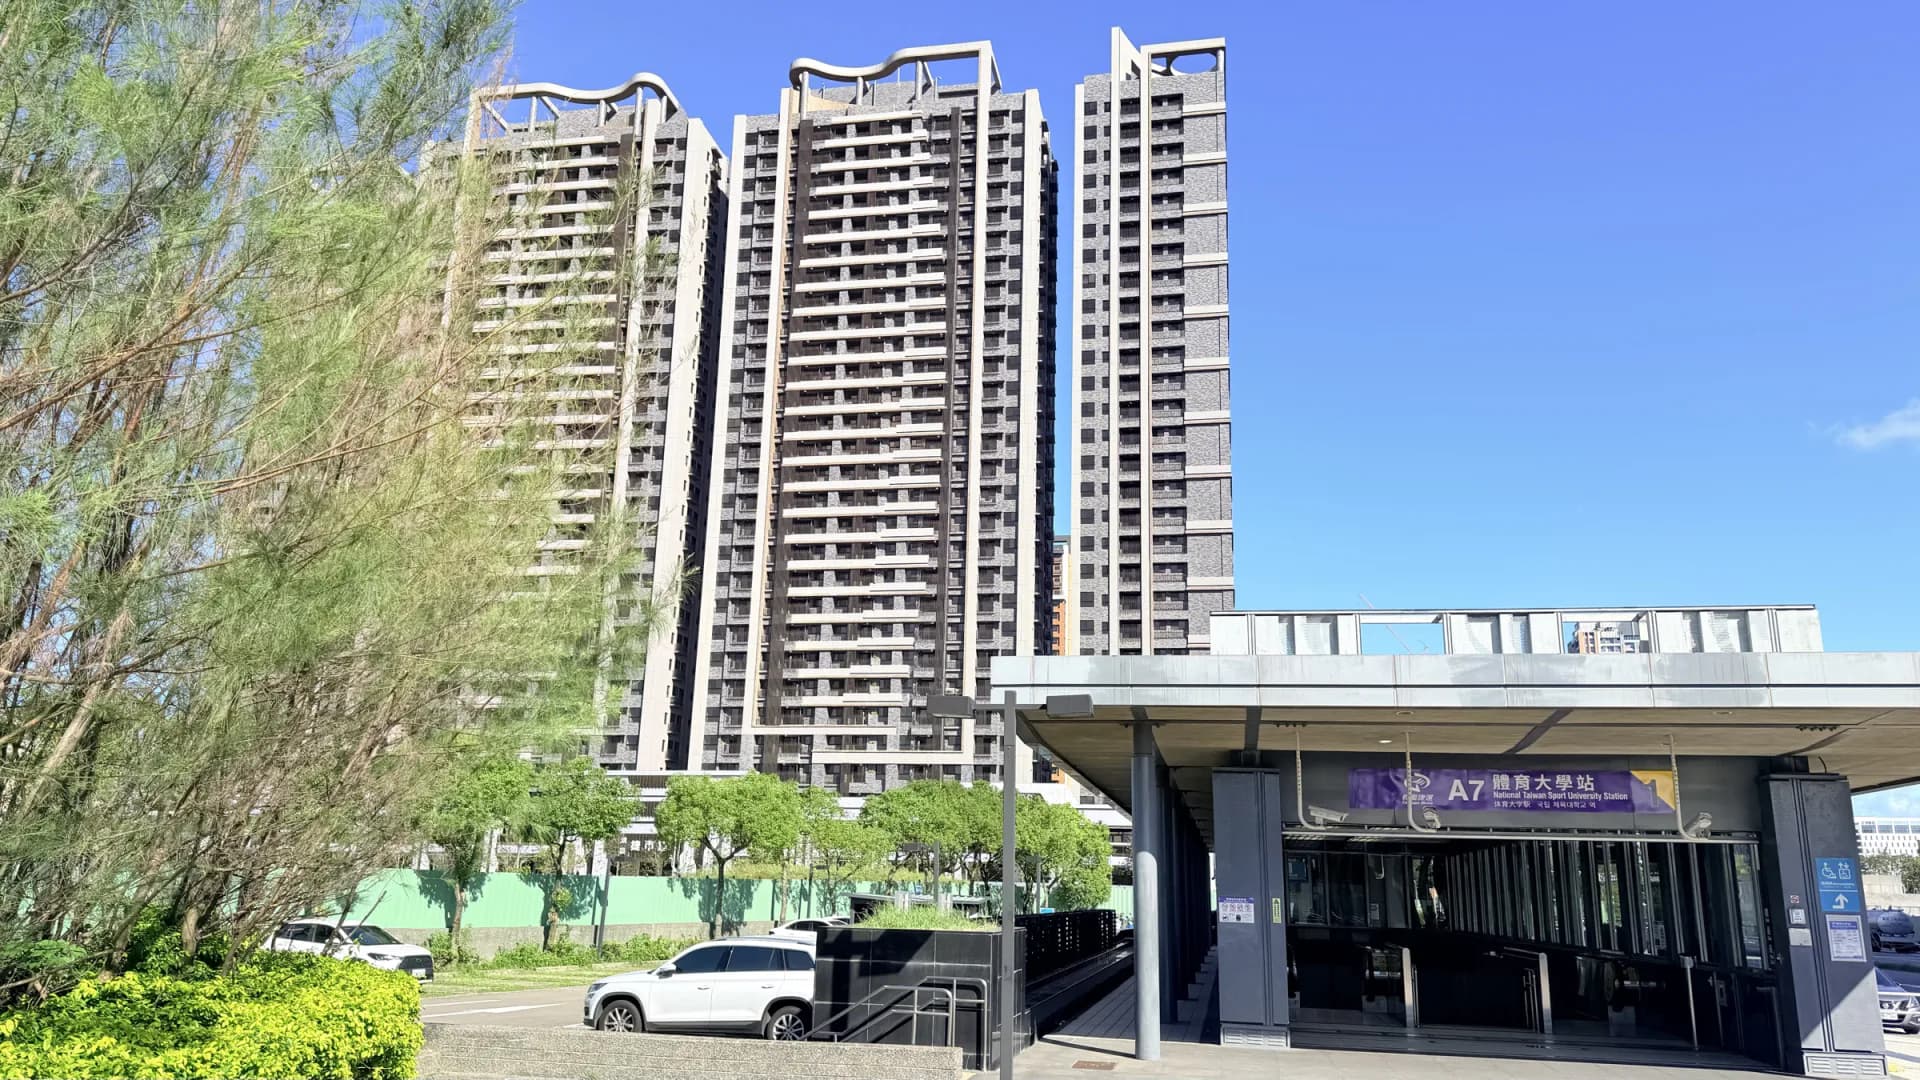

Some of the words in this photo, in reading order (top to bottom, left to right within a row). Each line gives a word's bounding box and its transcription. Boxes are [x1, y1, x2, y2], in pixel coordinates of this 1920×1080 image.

[1448, 779, 1485, 801] A7
[1492, 774, 1595, 791] 體育大學站
[1493, 791, 1521, 800] National
[1523, 791, 1547, 800] Taiwan
[1548, 791, 1567, 802] Sport
[1568, 791, 1602, 802] University
[1603, 792, 1628, 801] Station
